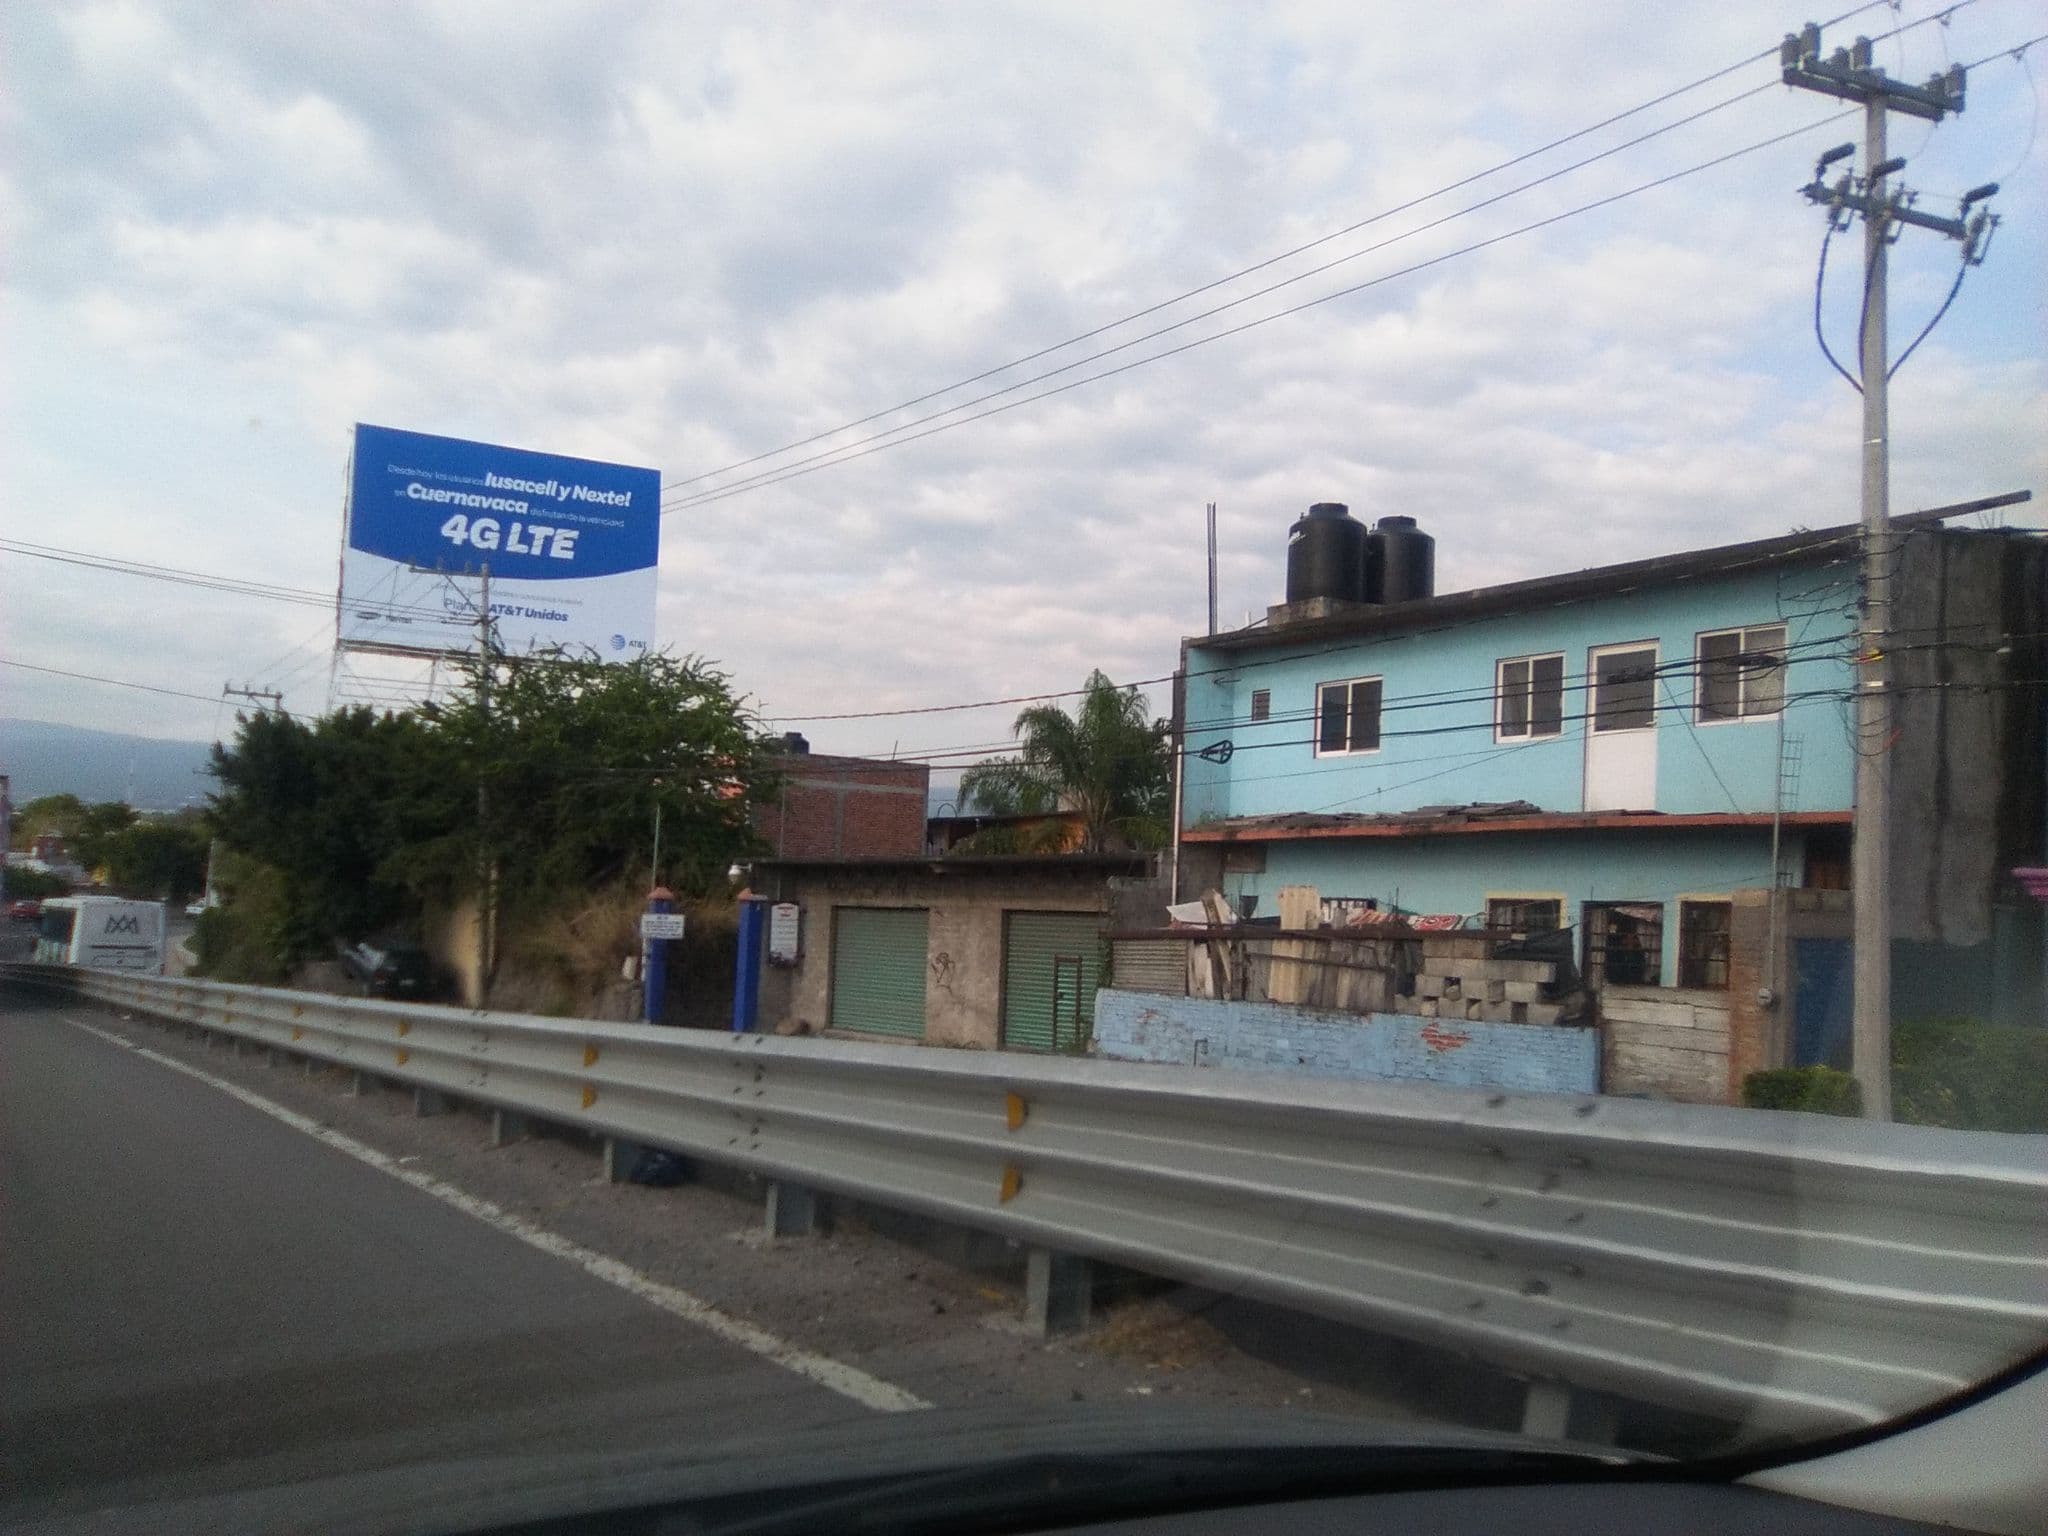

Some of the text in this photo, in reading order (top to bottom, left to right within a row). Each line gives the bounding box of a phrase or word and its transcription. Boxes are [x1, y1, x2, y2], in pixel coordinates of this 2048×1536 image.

[407, 482, 529, 514] Cuernavaca
[484, 472, 558, 497] Iusacell
[557, 485, 571, 501] y
[572, 485, 632, 507] Nextel
[441, 514, 580, 560] 4G LTE
[488, 603, 524, 616] AT&T
[525, 607, 569, 621] Unidos
